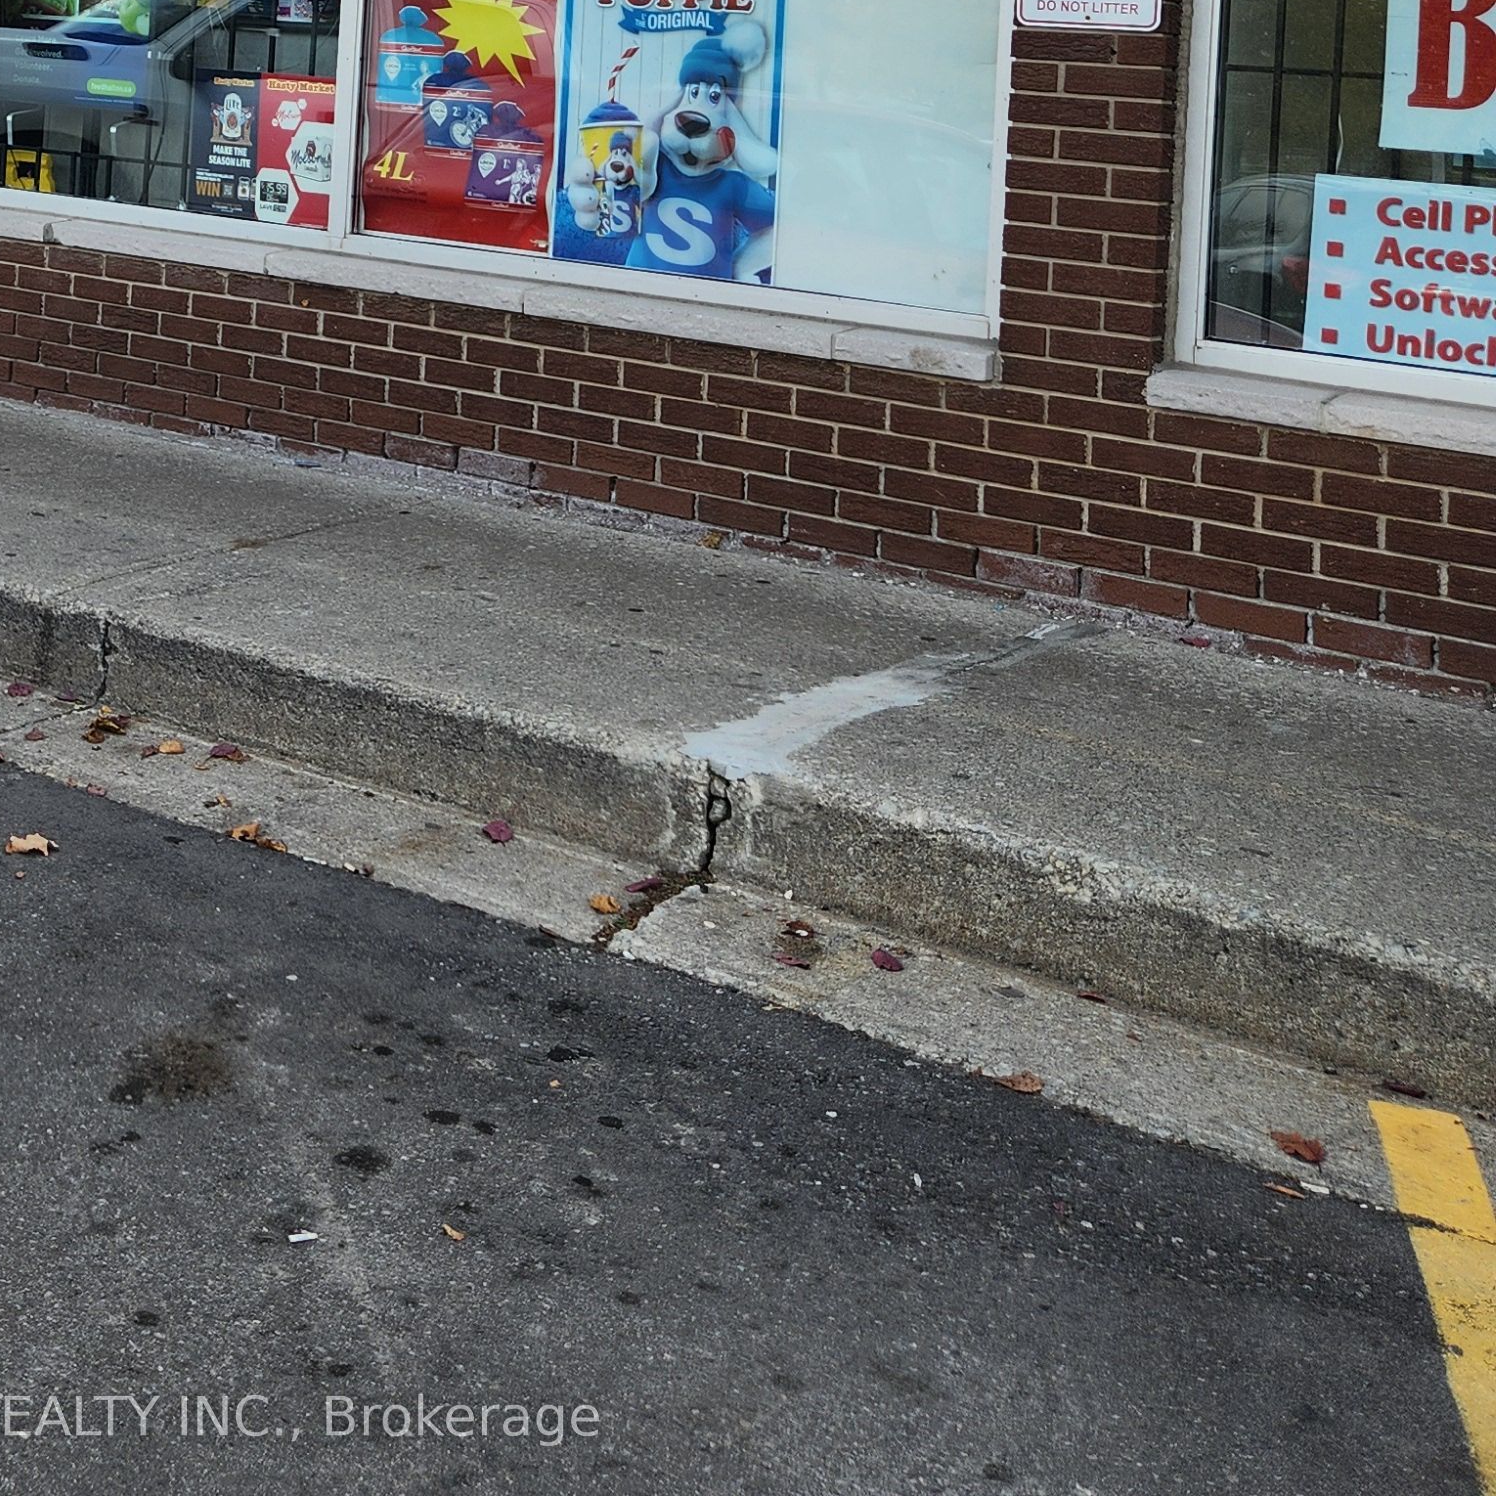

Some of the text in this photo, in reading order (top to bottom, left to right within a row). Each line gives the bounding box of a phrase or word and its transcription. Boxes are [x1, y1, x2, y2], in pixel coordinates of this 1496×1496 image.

[1036, 0, 1140, 15] DO NOT LITTER
[647, 10, 714, 30] ORIGINAL
[267, 79, 335, 94] Hasty Market
[212, 144, 248, 157] MAKE THE
[208, 155, 251, 169] SEASON LITE
[372, 149, 415, 181] 4L
[195, 180, 221, 199] WIN
[1376, 196, 1496, 237] Cell P
[645, 196, 717, 267] S
